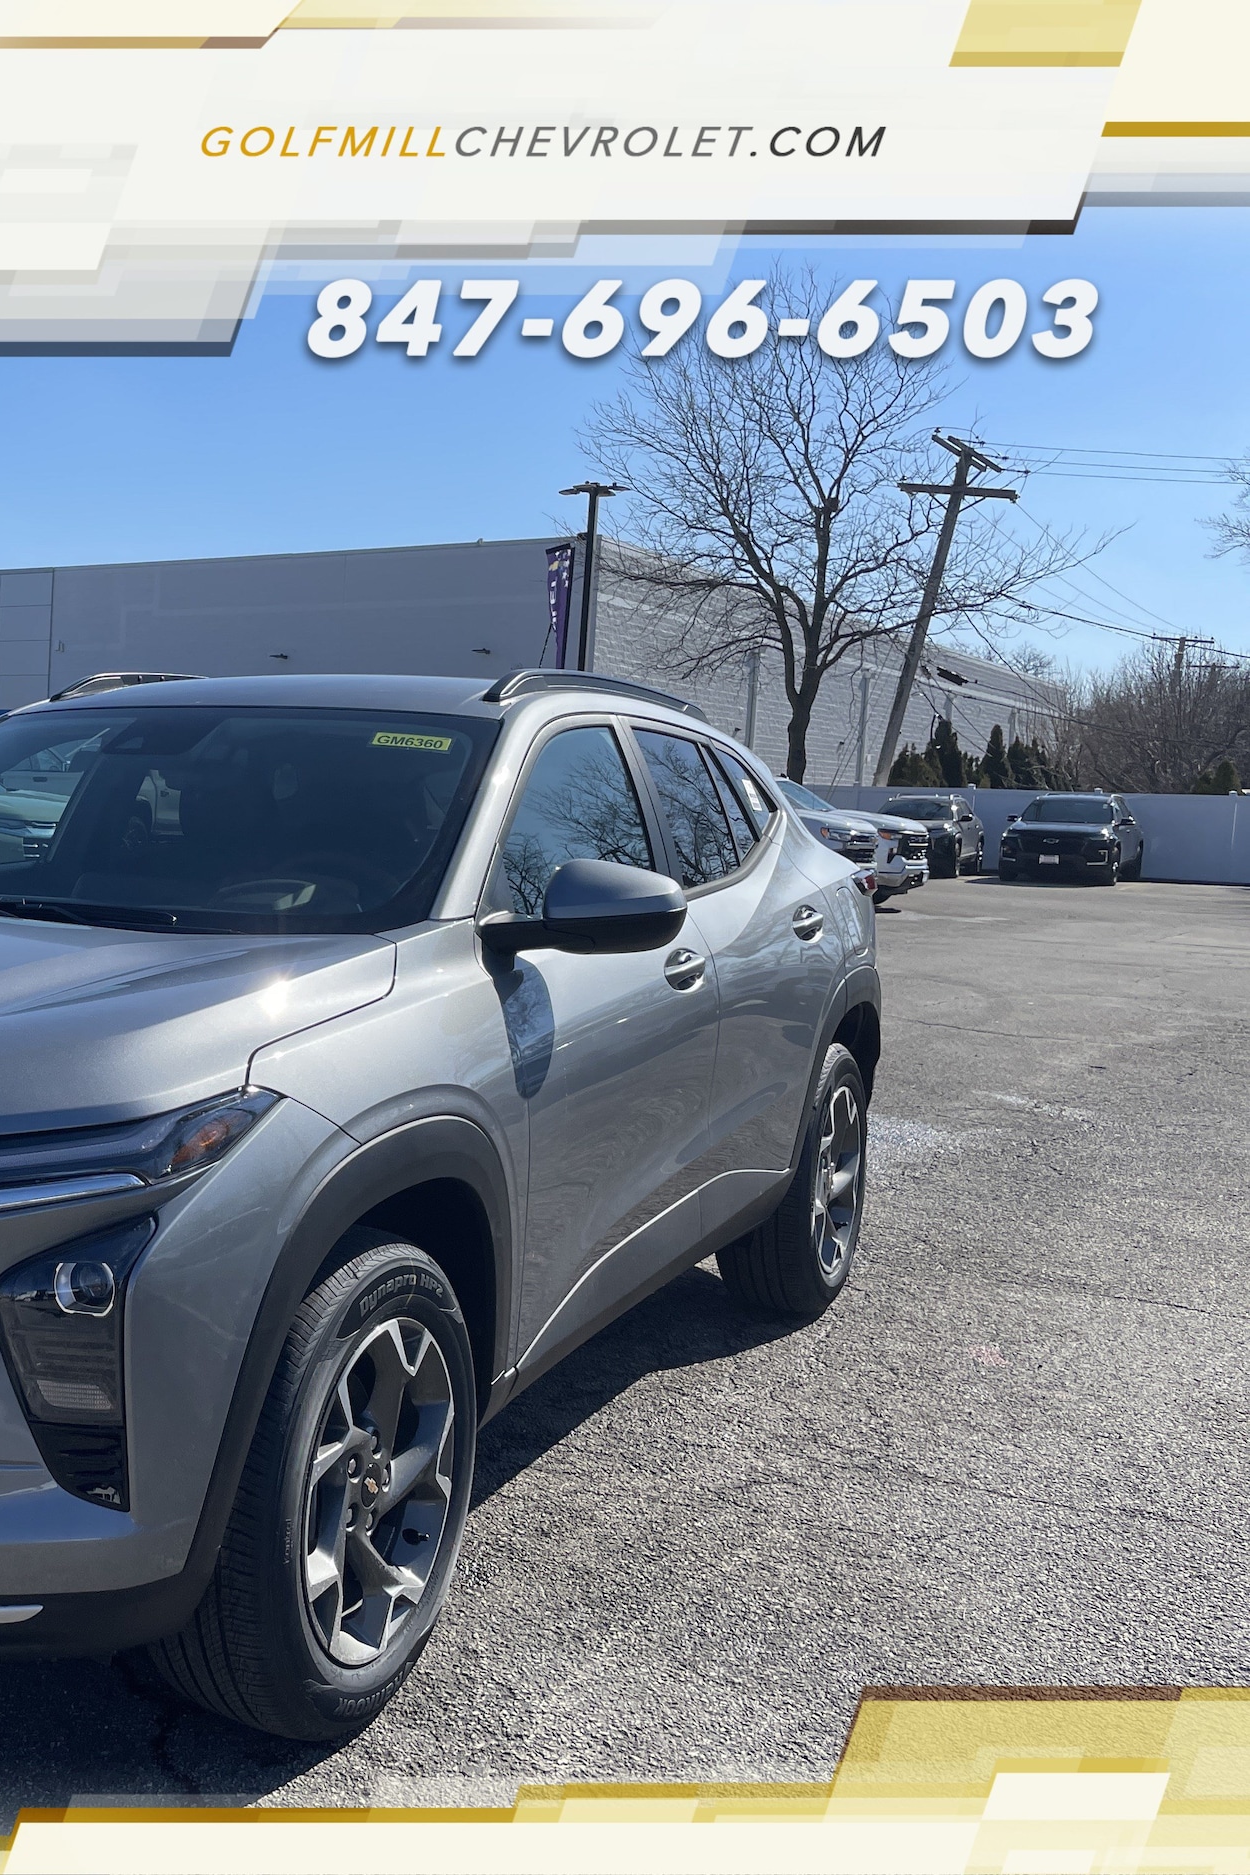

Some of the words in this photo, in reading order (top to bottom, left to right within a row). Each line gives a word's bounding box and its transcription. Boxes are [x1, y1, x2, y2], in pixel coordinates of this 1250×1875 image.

[377, 735, 443, 749] GM6360
[359, 1274, 417, 1317] Dynapro
[420, 1273, 443, 1298] HP2
